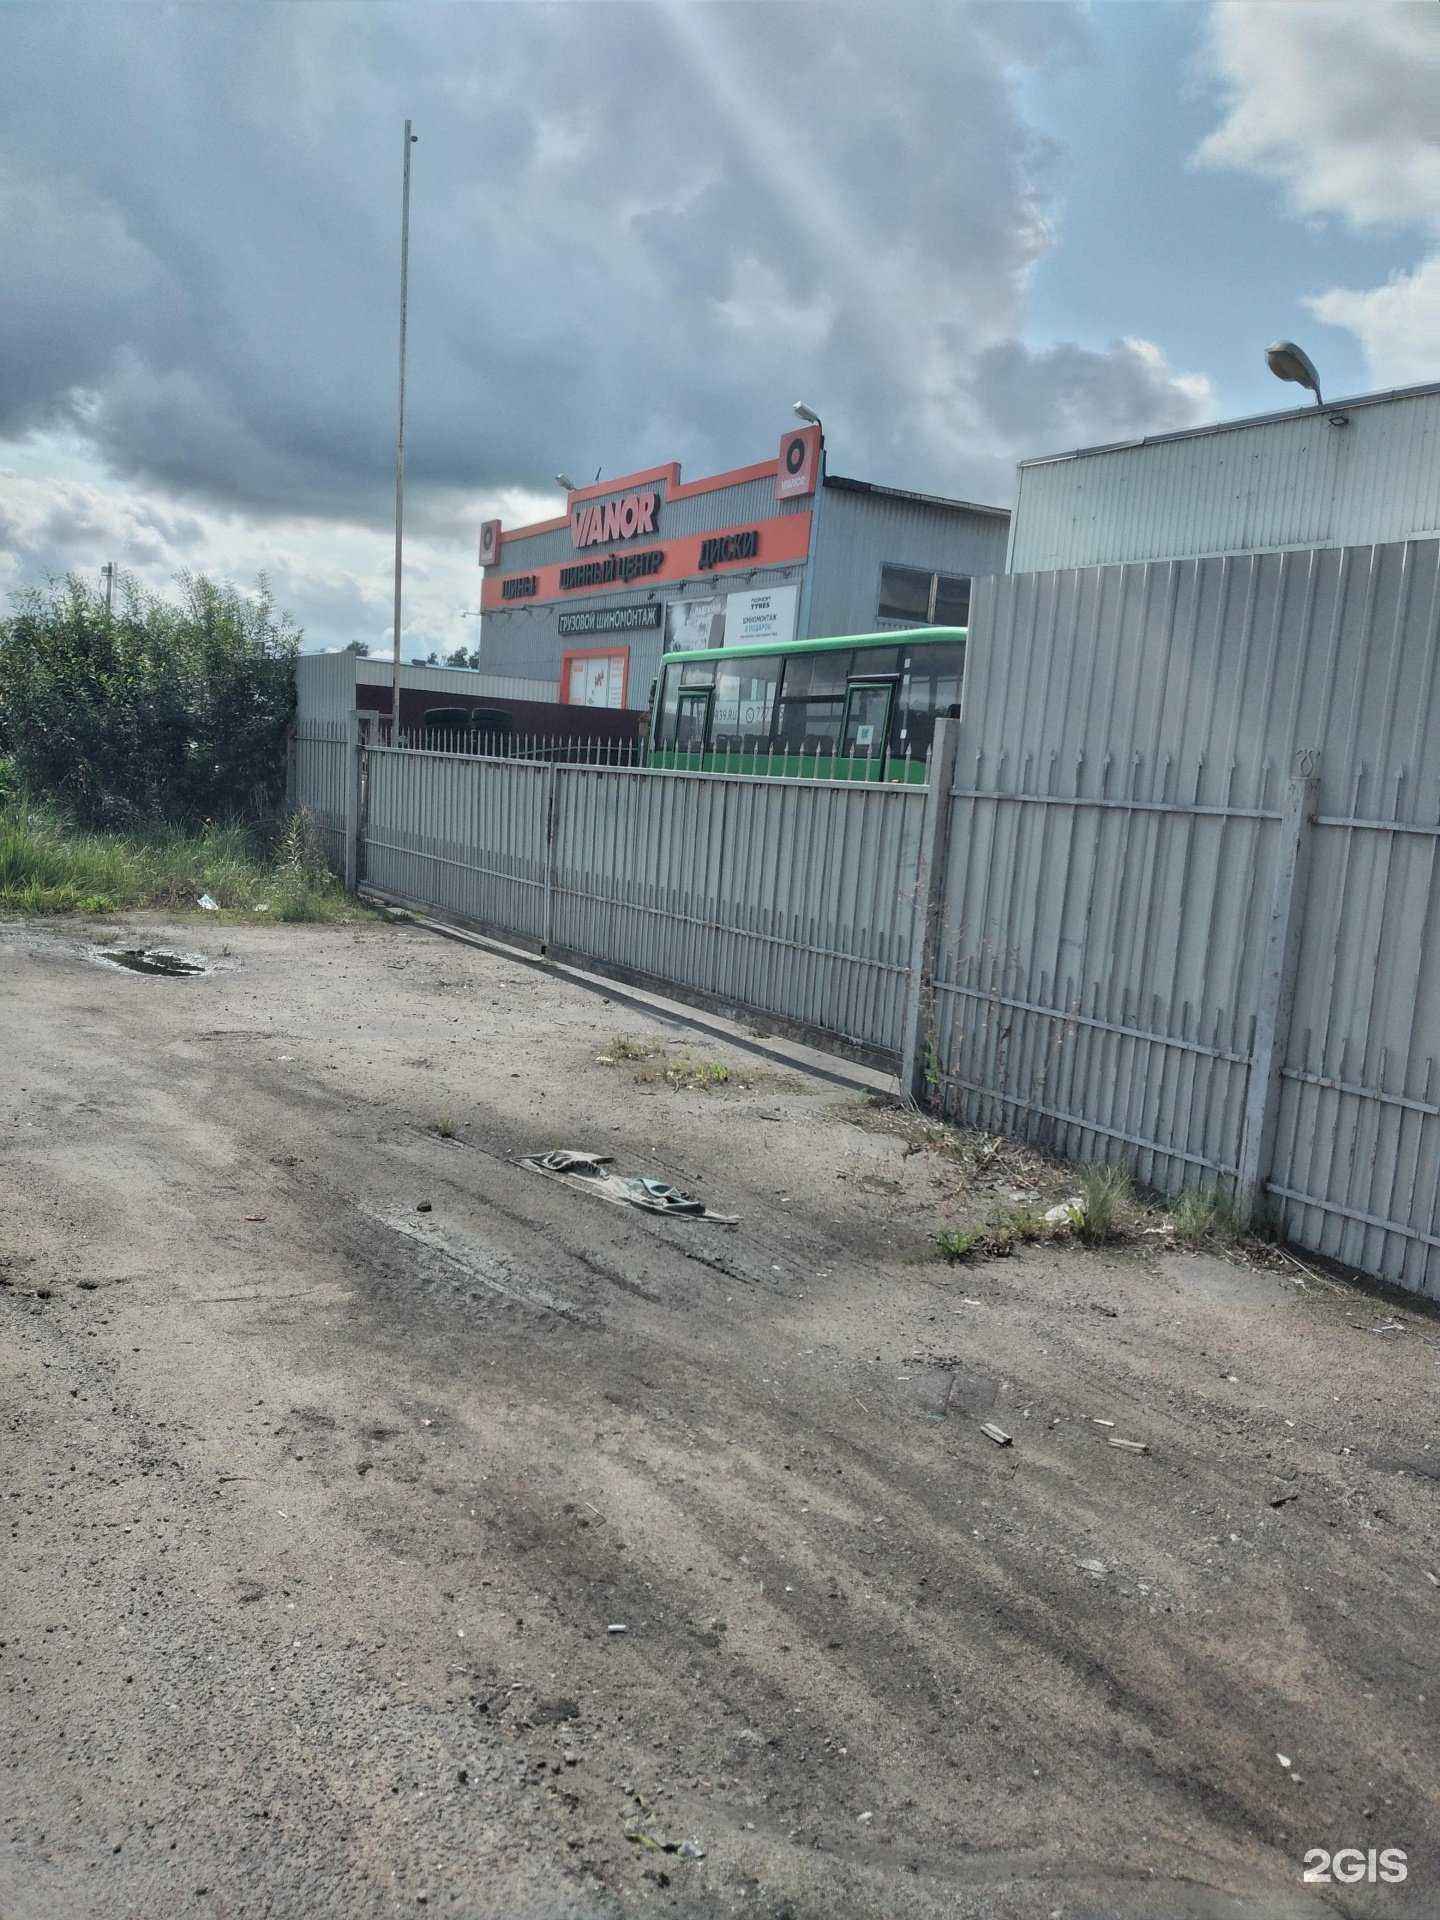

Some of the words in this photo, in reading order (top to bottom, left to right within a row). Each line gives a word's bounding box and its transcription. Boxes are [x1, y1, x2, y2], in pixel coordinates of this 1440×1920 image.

[570, 491, 658, 549] VIANOR
[698, 531, 759, 570] ДИСКИ
[503, 575, 538, 599] ШИНЫ
[559, 554, 616, 590] ШИННЫЙ
[617, 551, 664, 583] ЦЕНТР
[560, 612, 595, 632] ГРУЗОВОЙ
[597, 607, 656, 629] ШИНОМОНТАЖ
